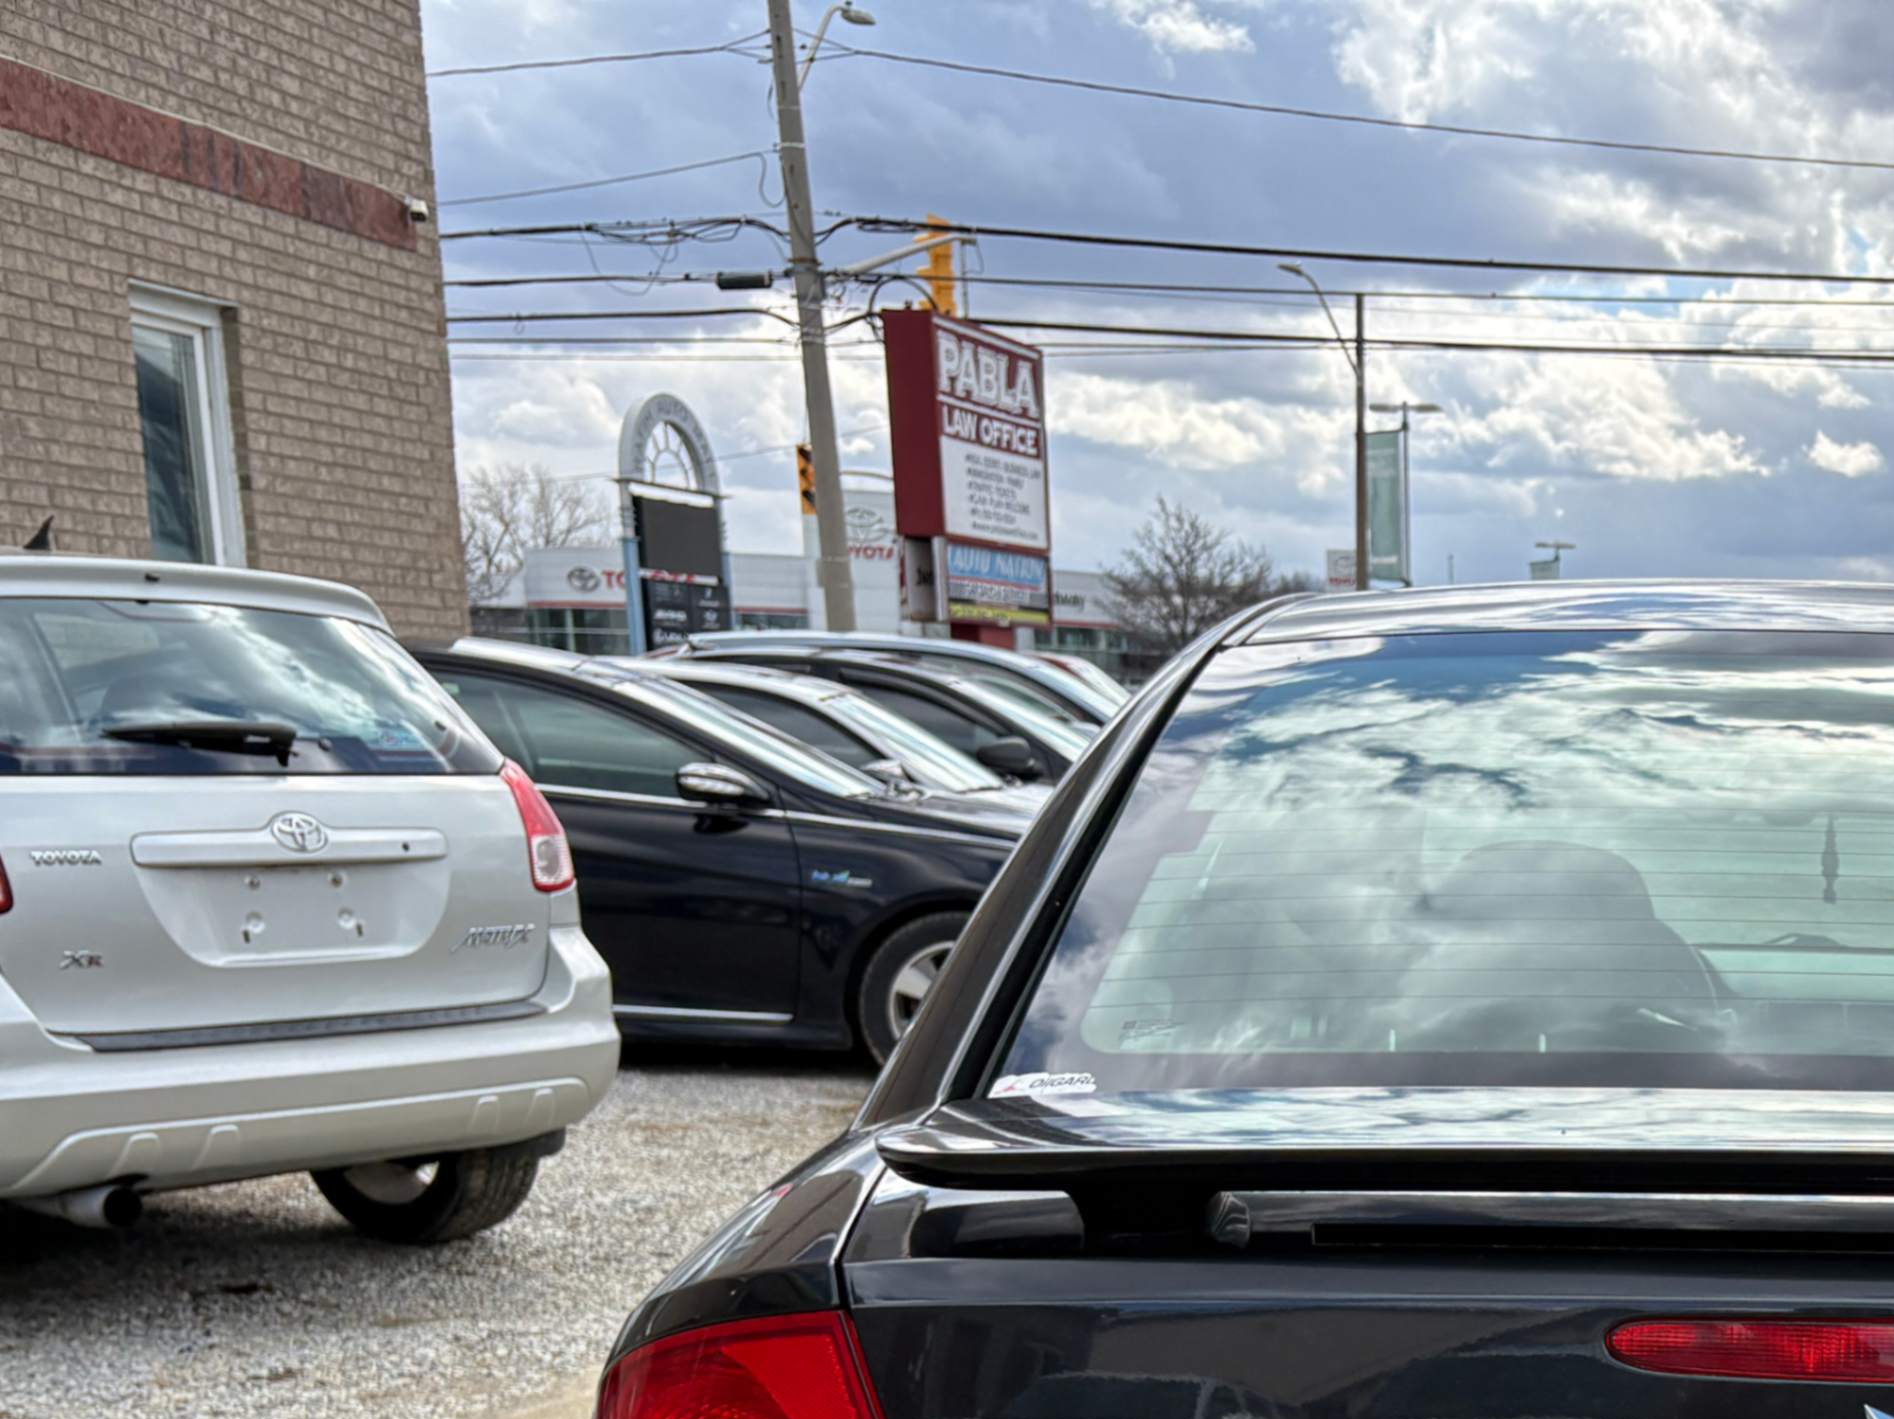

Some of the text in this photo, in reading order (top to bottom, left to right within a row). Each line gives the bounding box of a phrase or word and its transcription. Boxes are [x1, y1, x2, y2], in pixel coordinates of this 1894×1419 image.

[937, 330, 1040, 418] PABLA
[943, 404, 1038, 455] LAW OFFICE
[30, 849, 103, 867] TOYOTA
